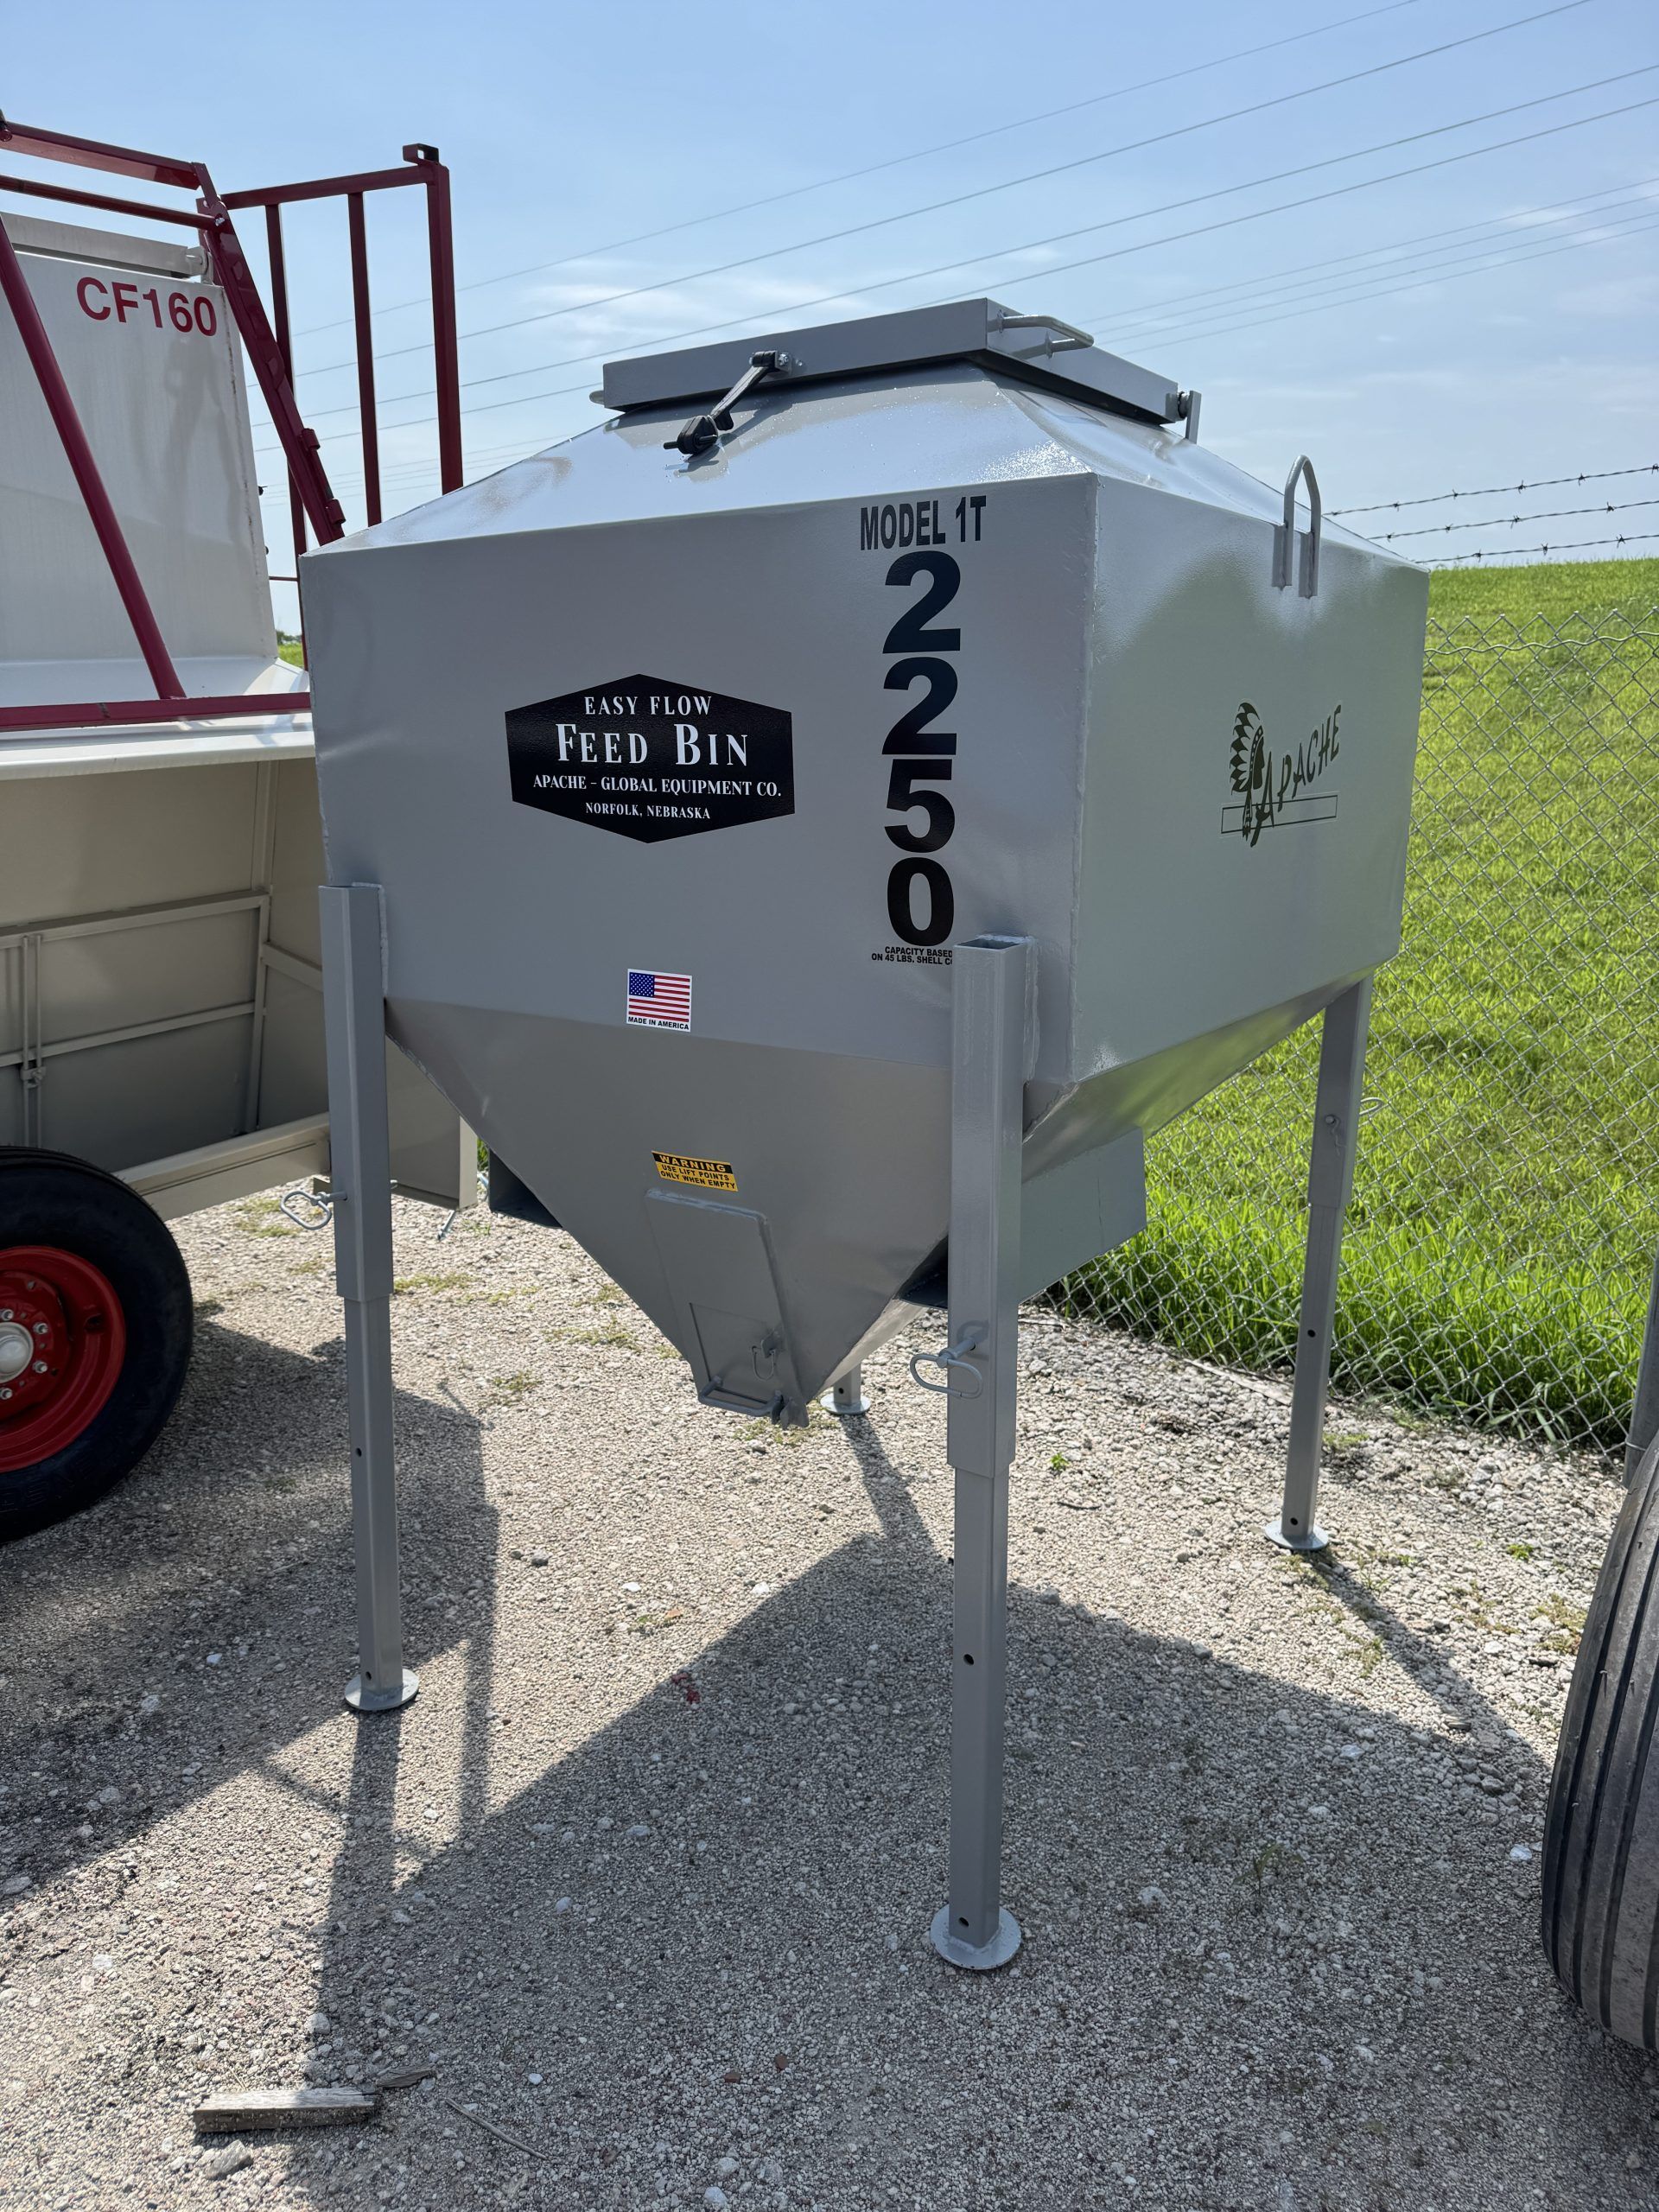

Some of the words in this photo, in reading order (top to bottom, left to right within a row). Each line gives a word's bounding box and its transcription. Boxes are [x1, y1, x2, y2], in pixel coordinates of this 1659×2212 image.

[77, 277, 217, 337] CF160
[861, 500, 946, 550] MODEL
[956, 495, 987, 543] 1T
[584, 696, 638, 715] EASY
[650, 696, 712, 715] FLOW
[881, 550, 961, 947] 2250
[1250, 704, 1342, 848] APACHE
[533, 774, 587, 790] APACHE
[601, 777, 658, 793] GLOBAL
[661, 779, 752, 797] EQUIPMENT
[756, 781, 782, 798] CO.
[586, 802, 643, 817] NORFOLK,
[646, 804, 711, 820] NEBRASKA
[871, 952, 883, 961] ON
[897, 955, 915, 963] LBS.
[917, 956, 943, 965] SHELL
[885, 946, 925, 956] CAPACITY
[926, 949, 952, 957] BASED
[627, 1016, 647, 1025] MADE
[658, 1020, 690, 1030] AMERICA
[659, 1155, 726, 1172] WARNING
[662, 1164, 677, 1173] USE
[679, 1167, 696, 1176] LIFT
[699, 1171, 729, 1181] POINTS
[660, 1170, 680, 1179] ONLY
[683, 1175, 706, 1185] WHEN
[709, 1179, 735, 1189] EMPTY
